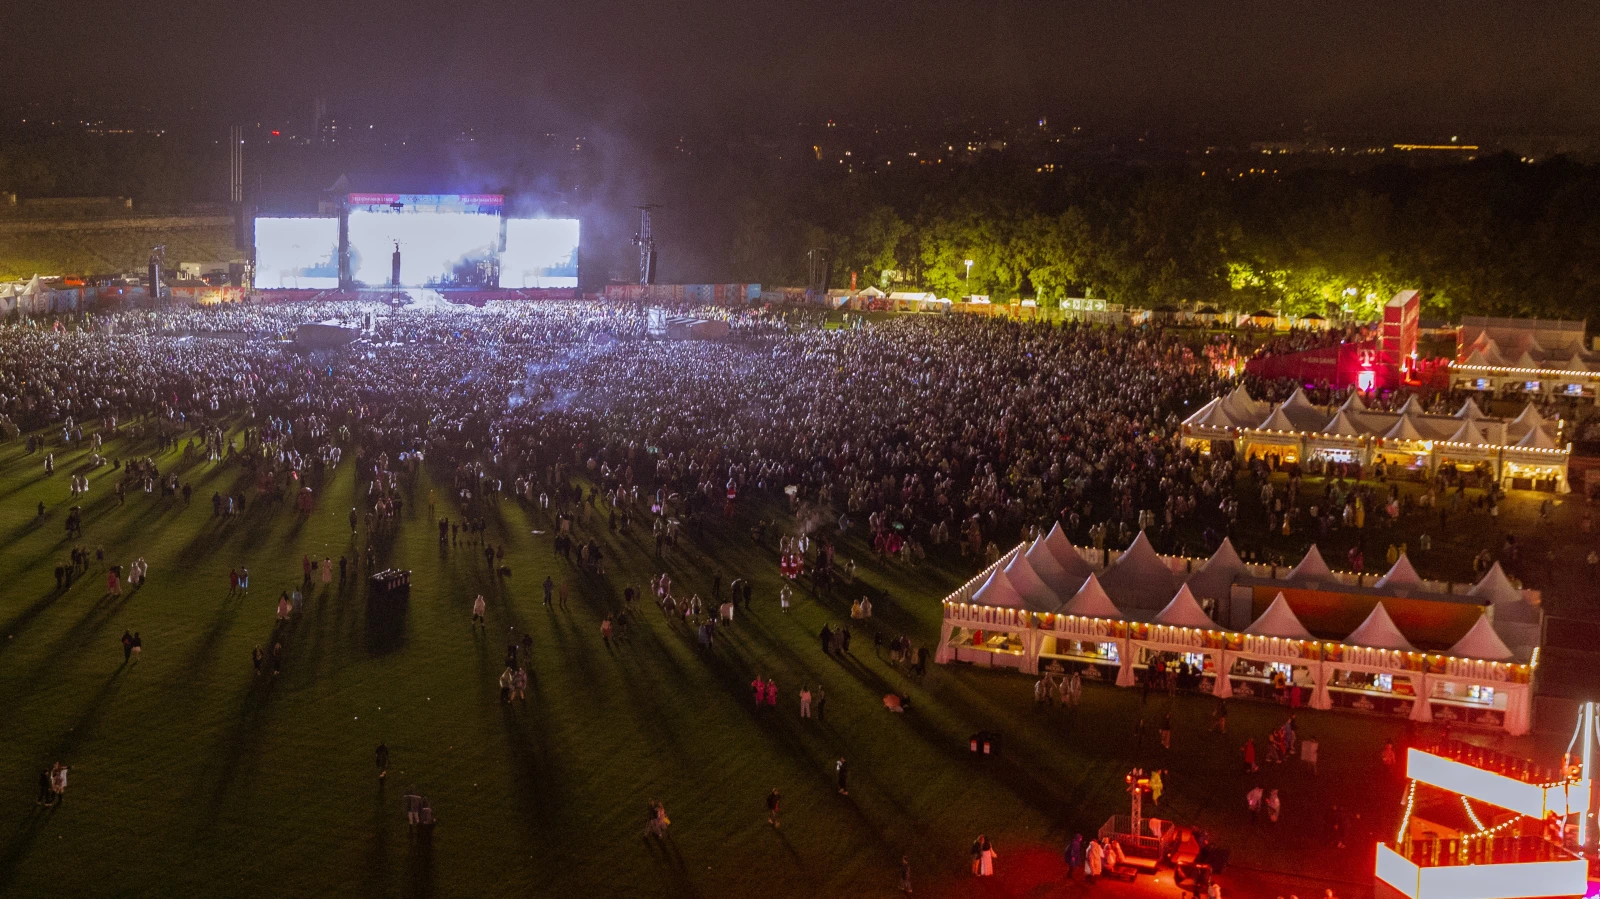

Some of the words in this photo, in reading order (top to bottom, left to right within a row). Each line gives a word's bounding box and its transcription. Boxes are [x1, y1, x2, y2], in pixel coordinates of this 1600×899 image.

[1359, 349, 1375, 367] T
[951, 603, 1027, 628] COCKTAILS
[1055, 614, 1108, 636] DRINKS
[1152, 625, 1203, 647] DRINKS
[1244, 634, 1300, 658] DRINKS
[1343, 645, 1401, 669] DRINKS
[1447, 658, 1506, 681] DRINKS
